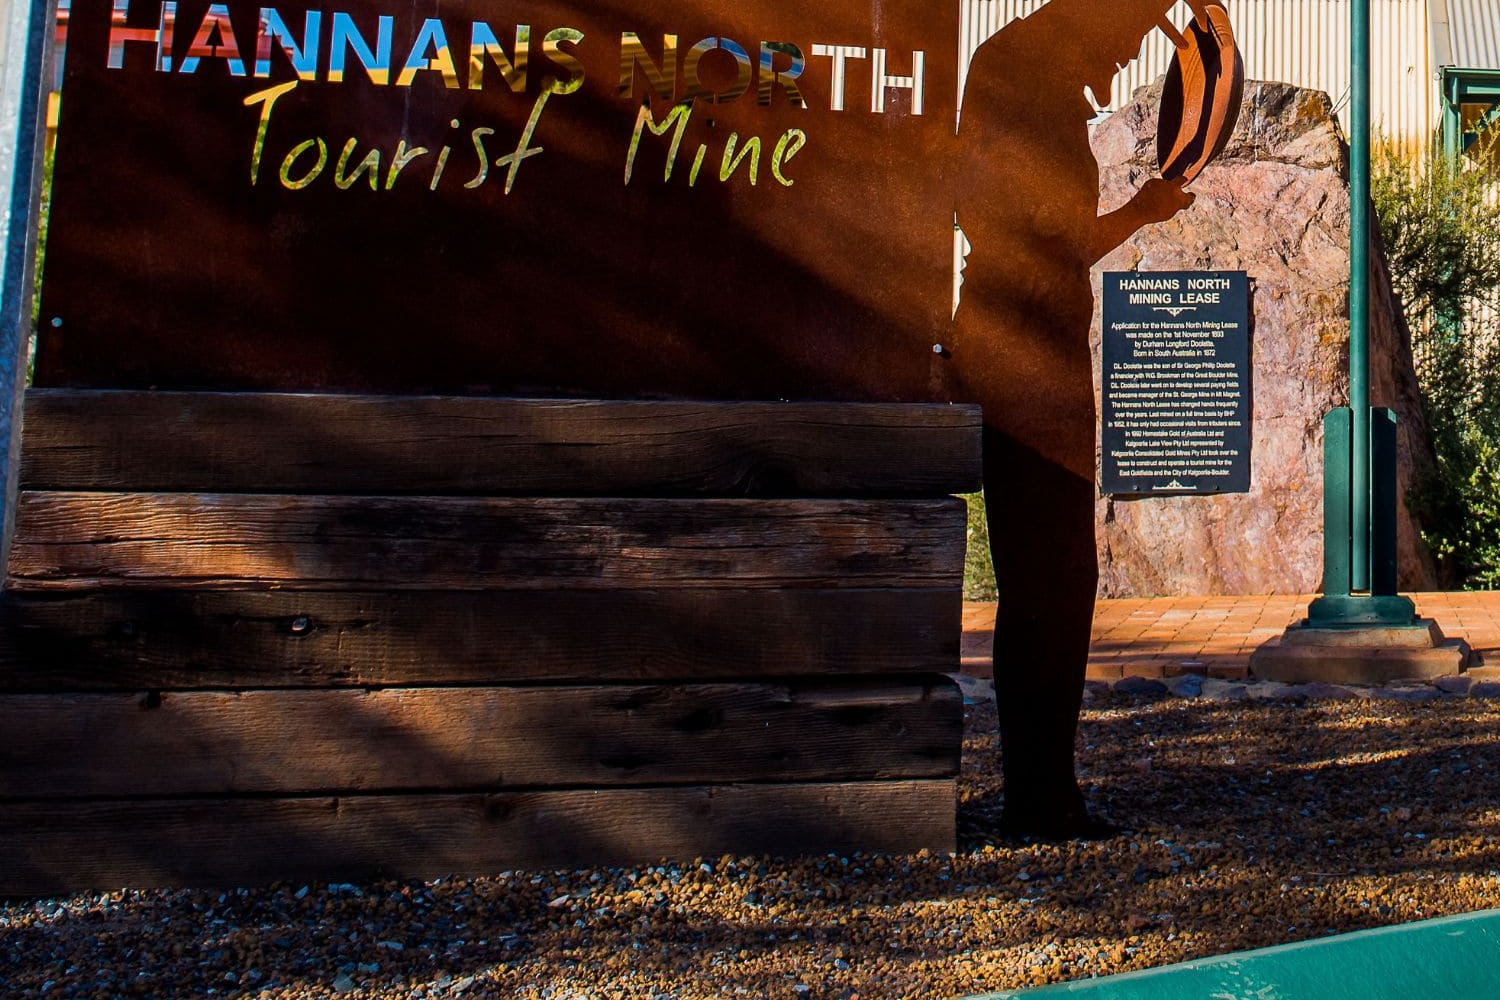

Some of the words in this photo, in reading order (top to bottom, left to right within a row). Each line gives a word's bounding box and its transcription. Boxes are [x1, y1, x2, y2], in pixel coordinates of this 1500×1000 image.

[619, 31, 924, 114] NORTH
[242, 79, 553, 194] Tourist
[622, 102, 806, 188] Mine
[1119, 279, 1180, 290] HANNANS
[1187, 279, 1231, 290] NORTH
[1129, 293, 1172, 304] MINING
[1179, 293, 1220, 304] LEASE
